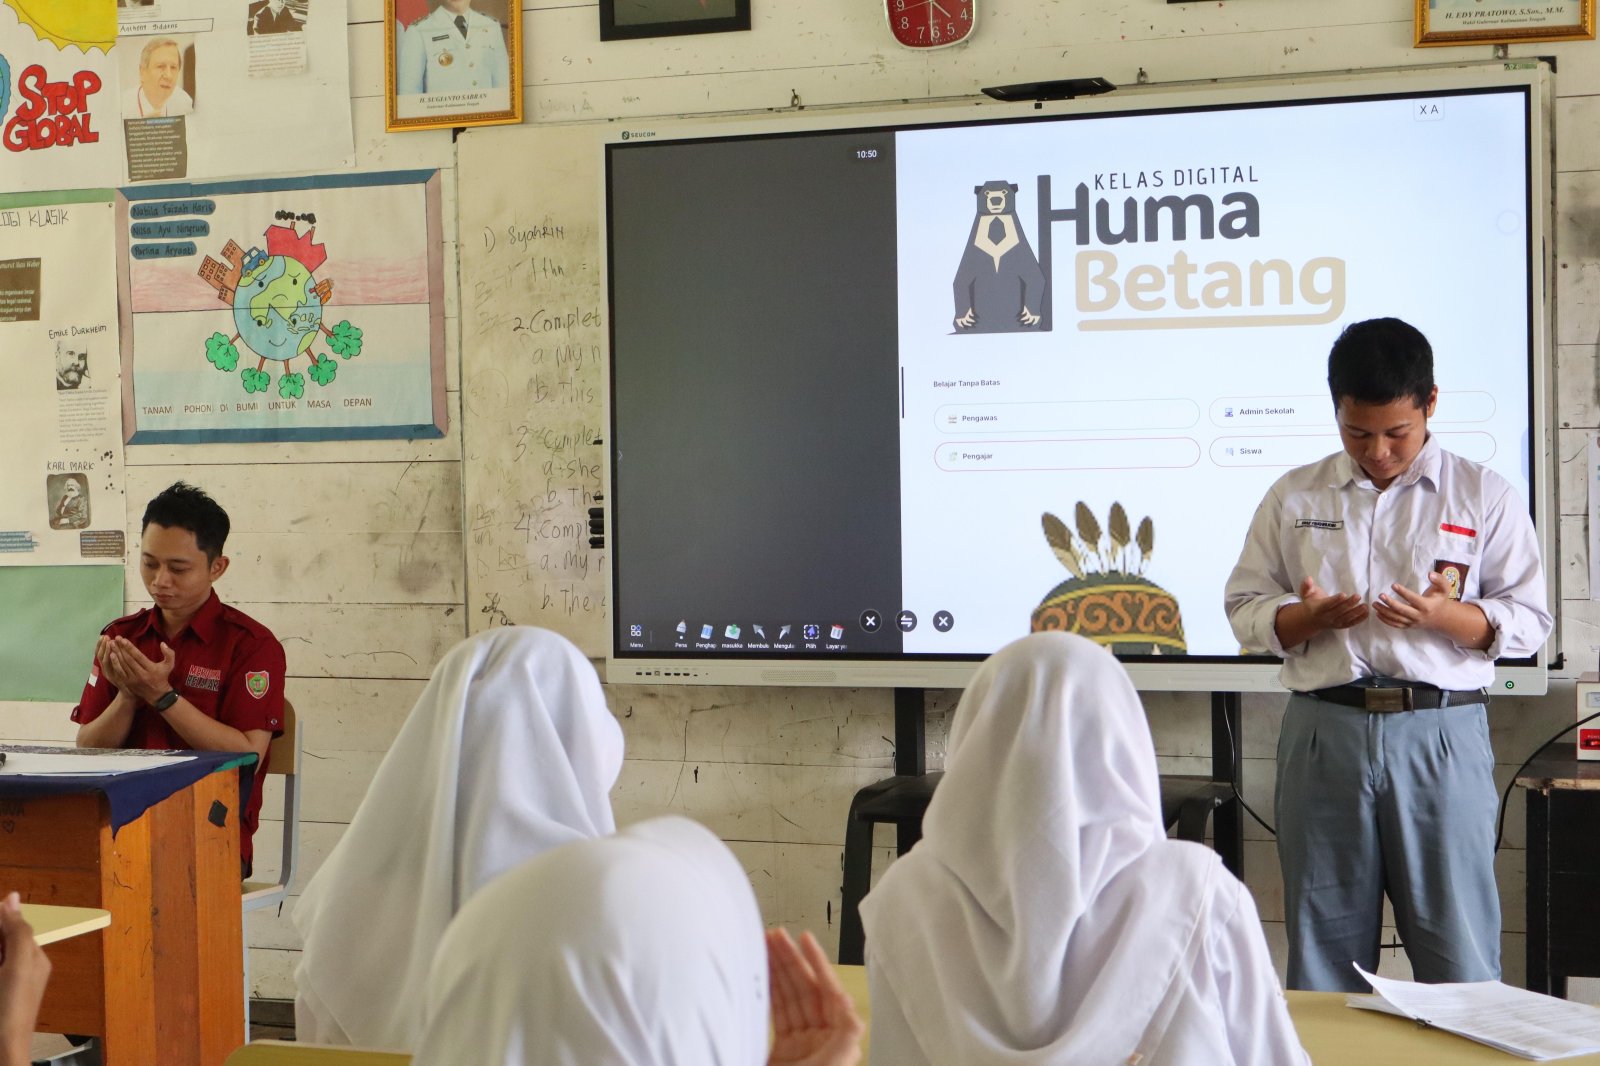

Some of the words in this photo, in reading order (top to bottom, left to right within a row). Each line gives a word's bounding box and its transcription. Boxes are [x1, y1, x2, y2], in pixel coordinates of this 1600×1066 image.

[896, 0, 905, 11] 9
[960, 8, 968, 20] 4
[901, 16, 909, 29] 8
[947, 22, 955, 35] 5
[917, 26, 925, 39] 7
[932, 26, 940, 39] 6
[16, 64, 102, 121] STOP
[3, 113, 99, 152] GLOBAL
[856, 149, 877, 159] 10:50
[1094, 170, 1165, 190] KELAS
[1174, 165, 1259, 186] DIGITAL
[1037, 175, 1260, 246] Huma
[29, 209, 70, 228] KLASIK
[1075, 250, 1346, 332] Betang
[933, 380, 957, 388] Belajar
[958, 380, 980, 388] Tanpa
[142, 405, 173, 415] TANAM
[184, 404, 212, 413] POHON
[236, 403, 259, 412] BUMI
[268, 401, 297, 411] UNTUK
[307, 400, 332, 409] MASA
[343, 397, 372, 407] DEPAN
[1265, 407, 1295, 415] Sekolah
[962, 414, 998, 422] Pengawas
[962, 452, 993, 461] Pengajar
[1239, 447, 1262, 455] Siswa
[46, 460, 66, 471] KARL
[69, 460, 95, 471] MARK
